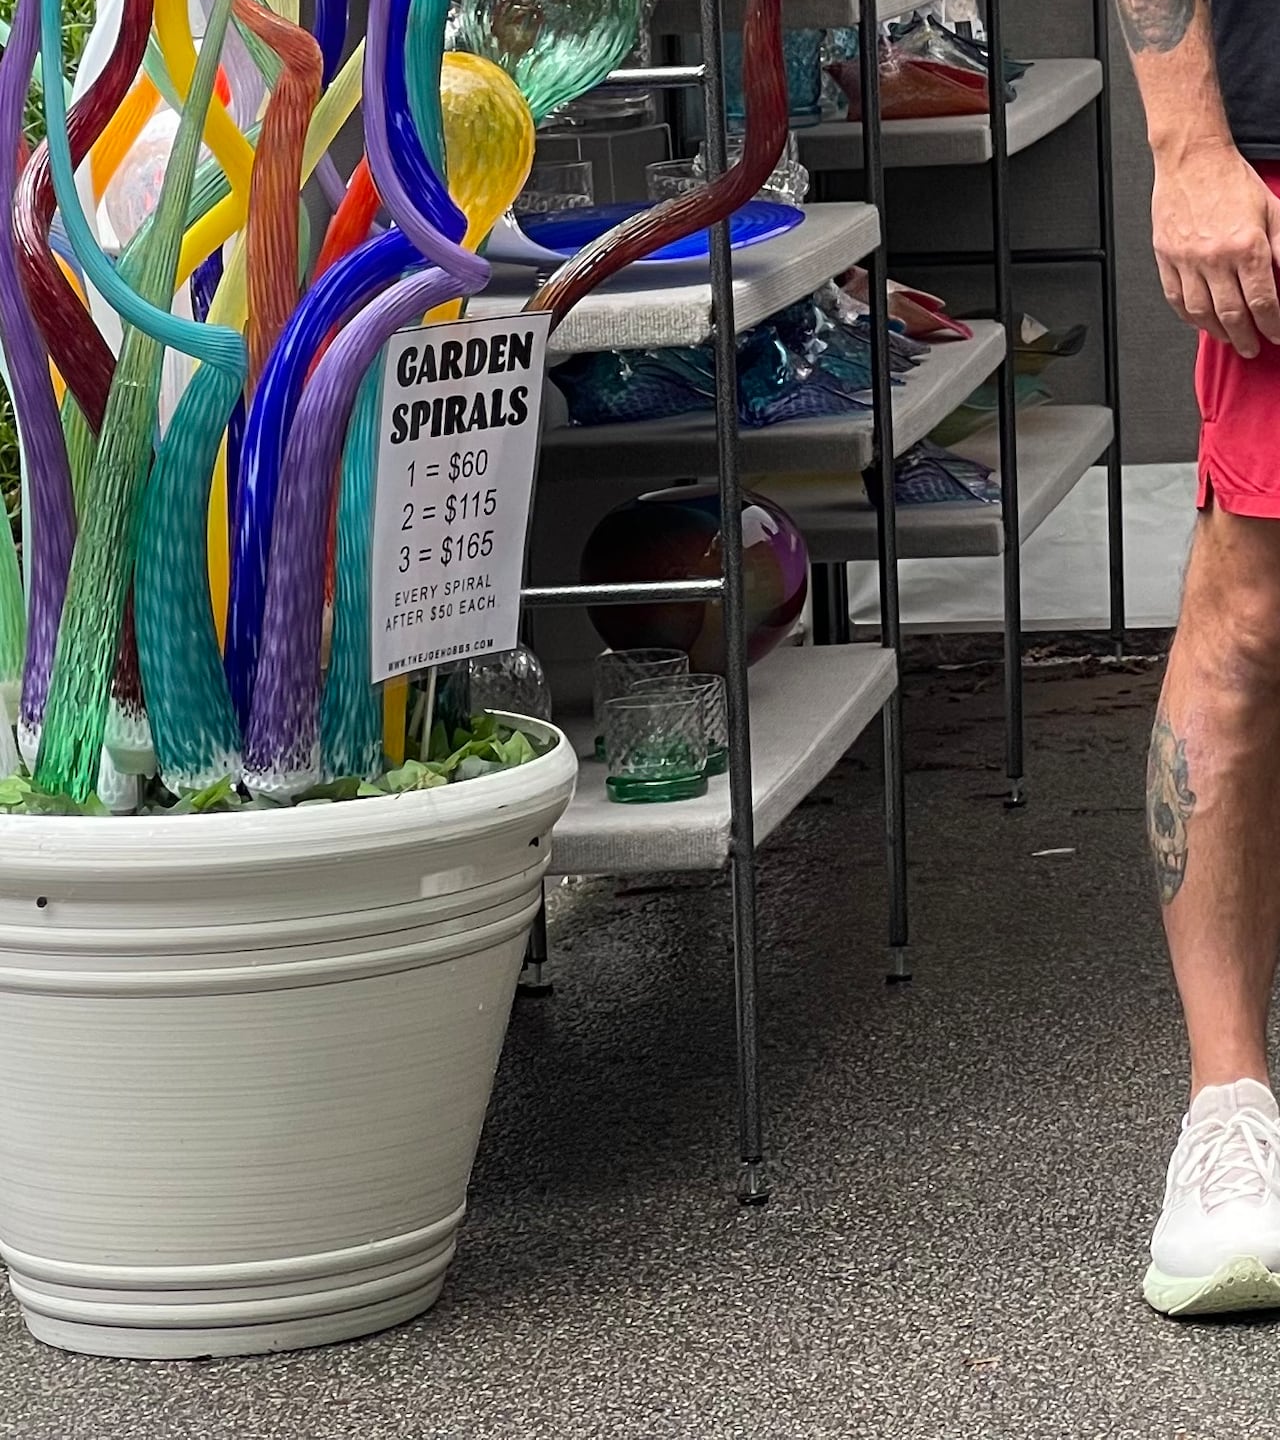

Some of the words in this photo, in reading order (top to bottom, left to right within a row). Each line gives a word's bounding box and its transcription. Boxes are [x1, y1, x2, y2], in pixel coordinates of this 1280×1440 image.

[397, 331, 534, 388] GARDEN
[390, 386, 529, 445] SPIRALS
[406, 460, 416, 488] 1
[448, 449, 489, 484] $60
[401, 503, 414, 531] 2
[445, 488, 498, 525] $115
[398, 545, 411, 573] 3
[440, 530, 495, 568] $165
[394, 584, 438, 607] EVERY
[444, 574, 492, 596] SPIRAL
[385, 609, 424, 633] AFTER
[430, 603, 453, 621] $50
[459, 594, 496, 615] EACH
